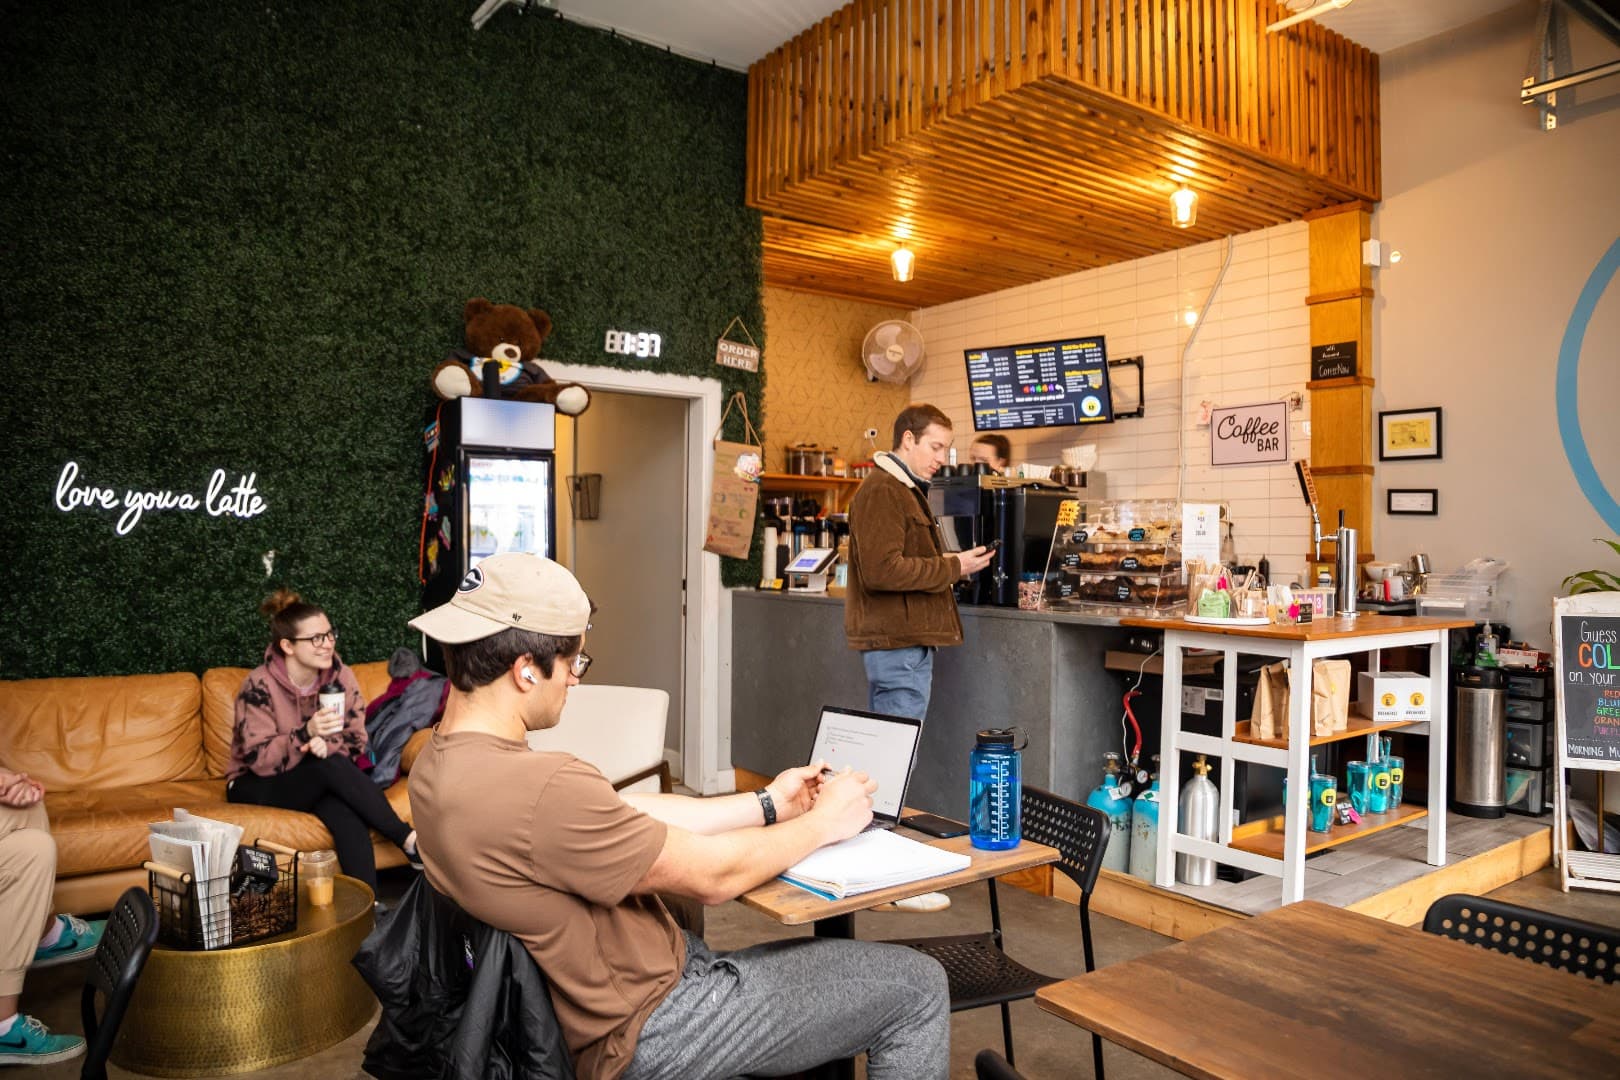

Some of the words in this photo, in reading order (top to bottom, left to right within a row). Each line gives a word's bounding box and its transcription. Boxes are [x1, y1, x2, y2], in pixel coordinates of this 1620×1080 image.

[719, 342, 759, 359] ORDER
[723, 355, 753, 370] HERE
[1217, 413, 1280, 445] Coffee
[1257, 437, 1279, 452] BAR
[55, 461, 119, 512] love
[116, 489, 180, 536] you
[205, 468, 267, 518] latte
[1580, 620, 1617, 643] Guess
[1569, 671, 1583, 682] on
[1567, 743, 1604, 757] MORNING
